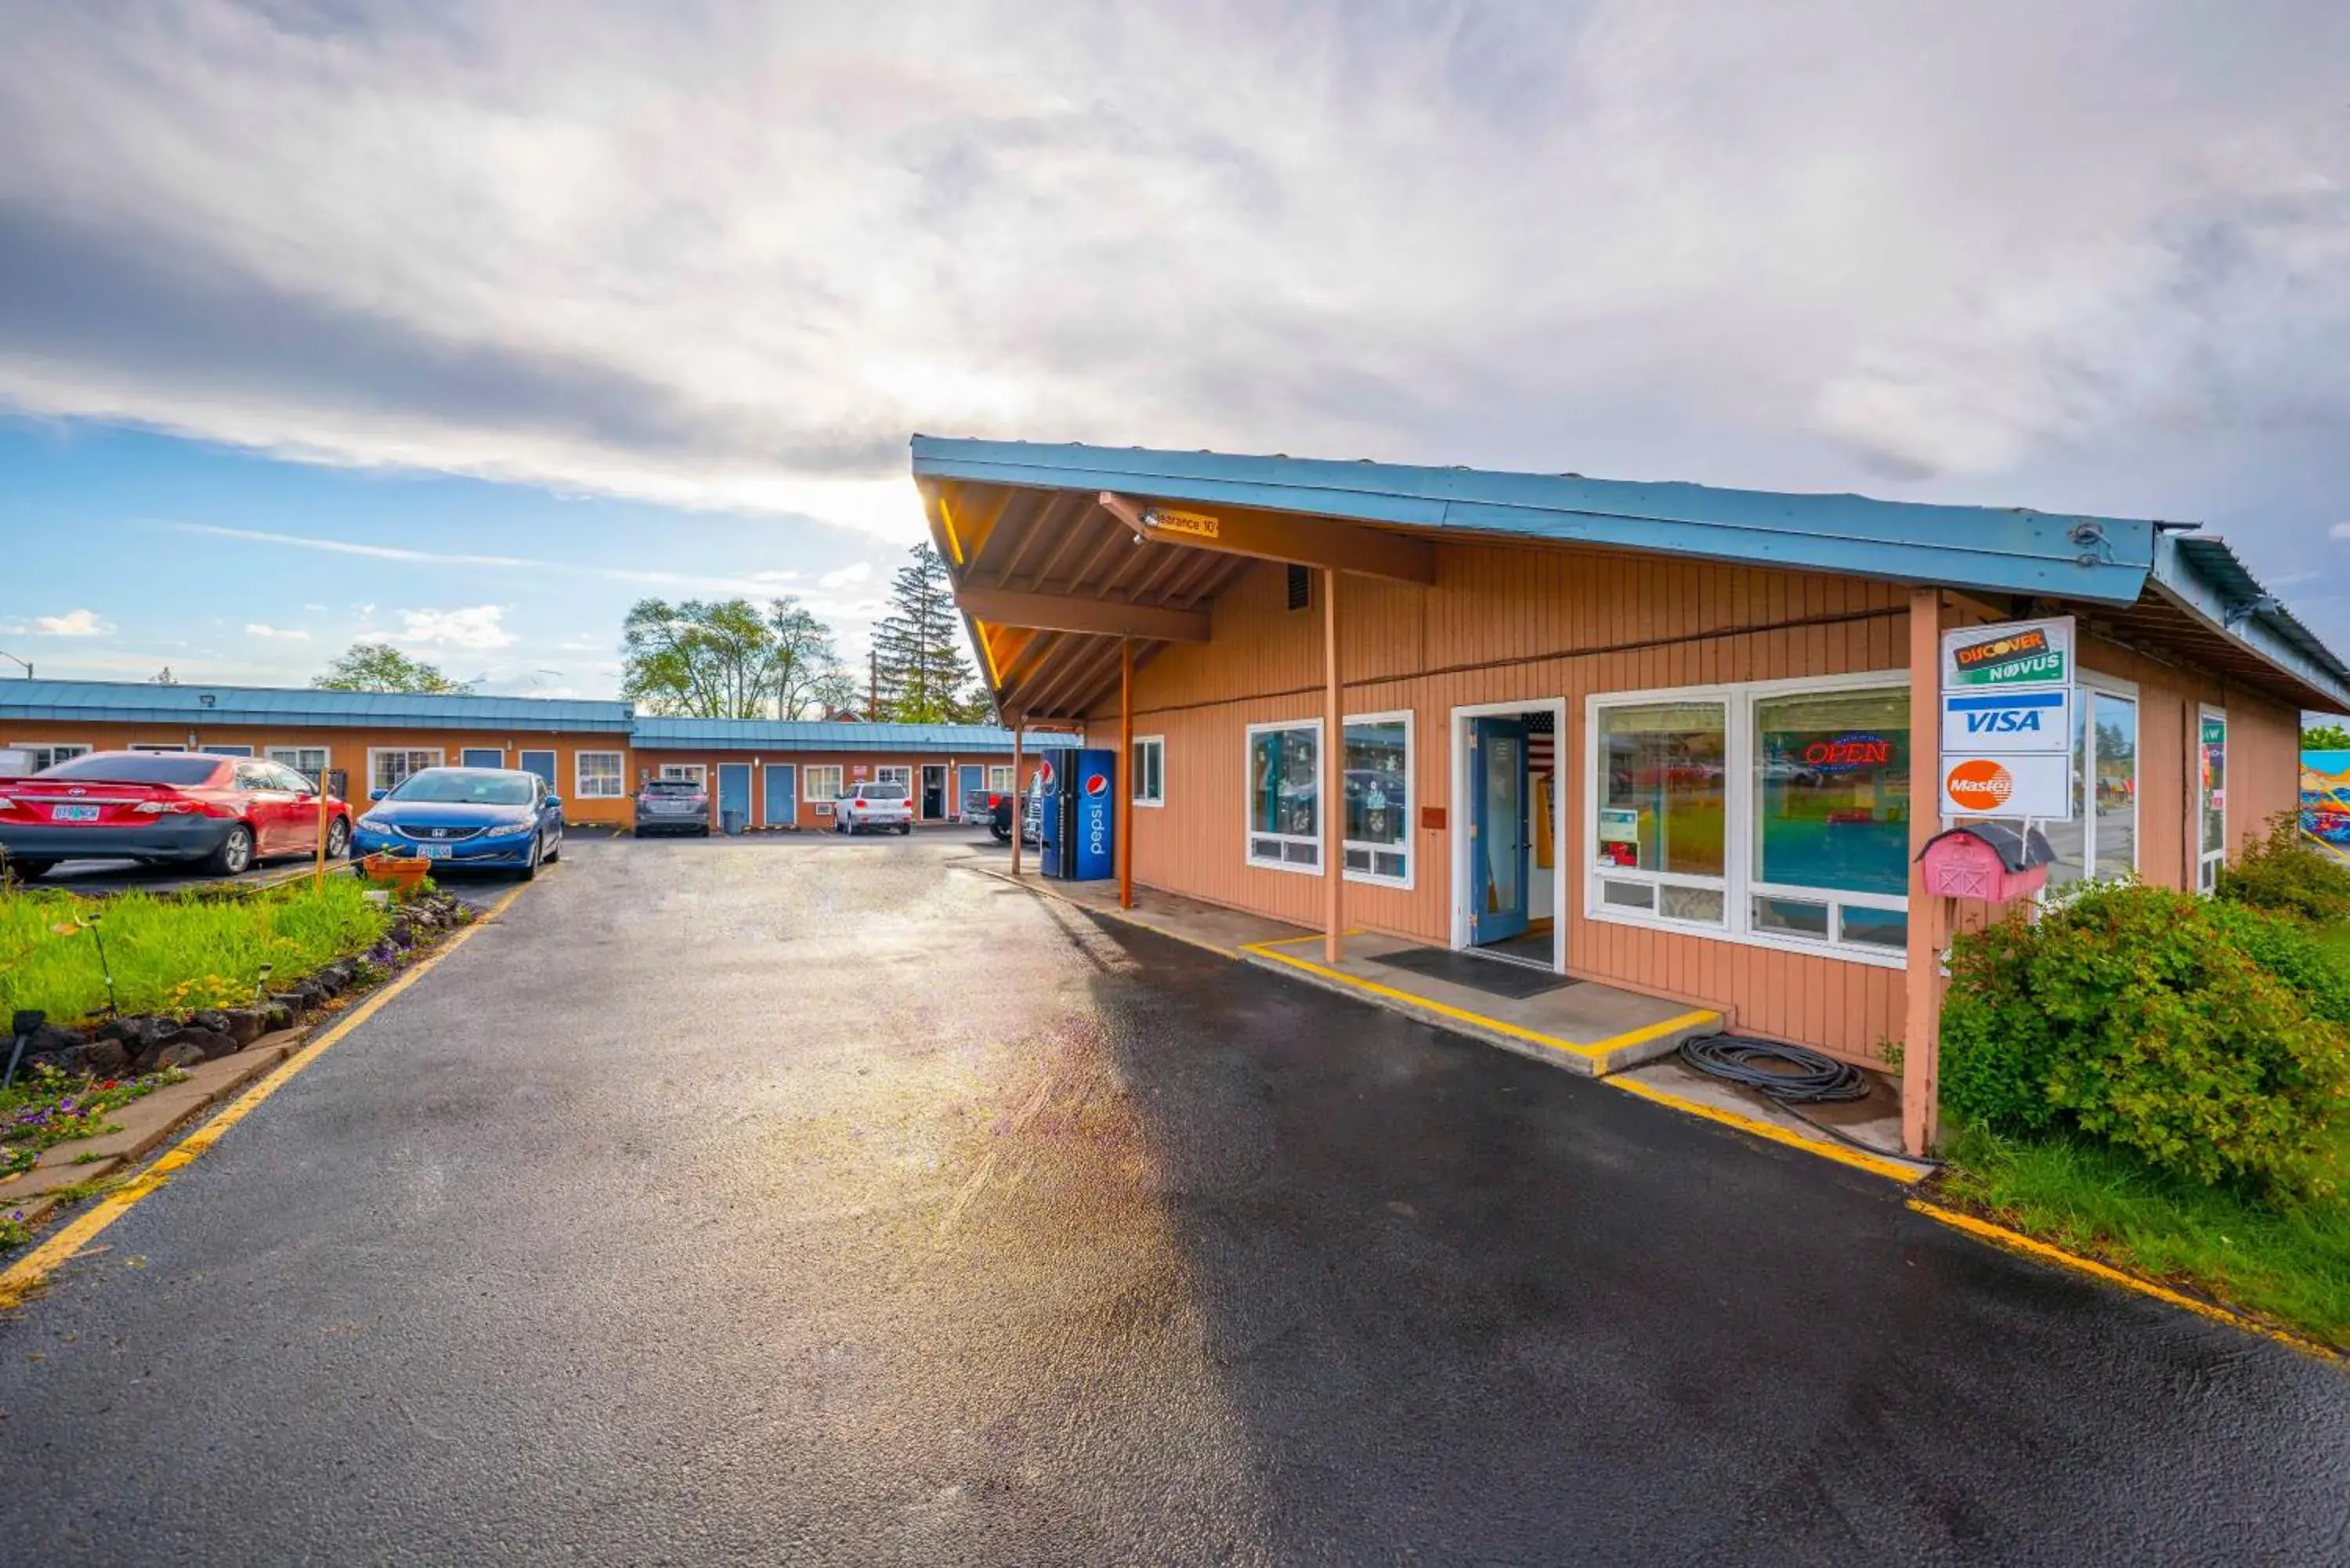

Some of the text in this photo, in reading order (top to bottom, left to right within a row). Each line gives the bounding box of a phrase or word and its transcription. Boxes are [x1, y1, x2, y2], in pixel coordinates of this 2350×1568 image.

[1959, 632, 2044, 664] DISCOVER
[1990, 654, 2059, 681] NOVUS
[1966, 710, 2041, 733] VISA
[1804, 740, 1891, 765] OPEN
[1950, 779, 2011, 793] Master
[1090, 803, 1104, 854] pepsi
